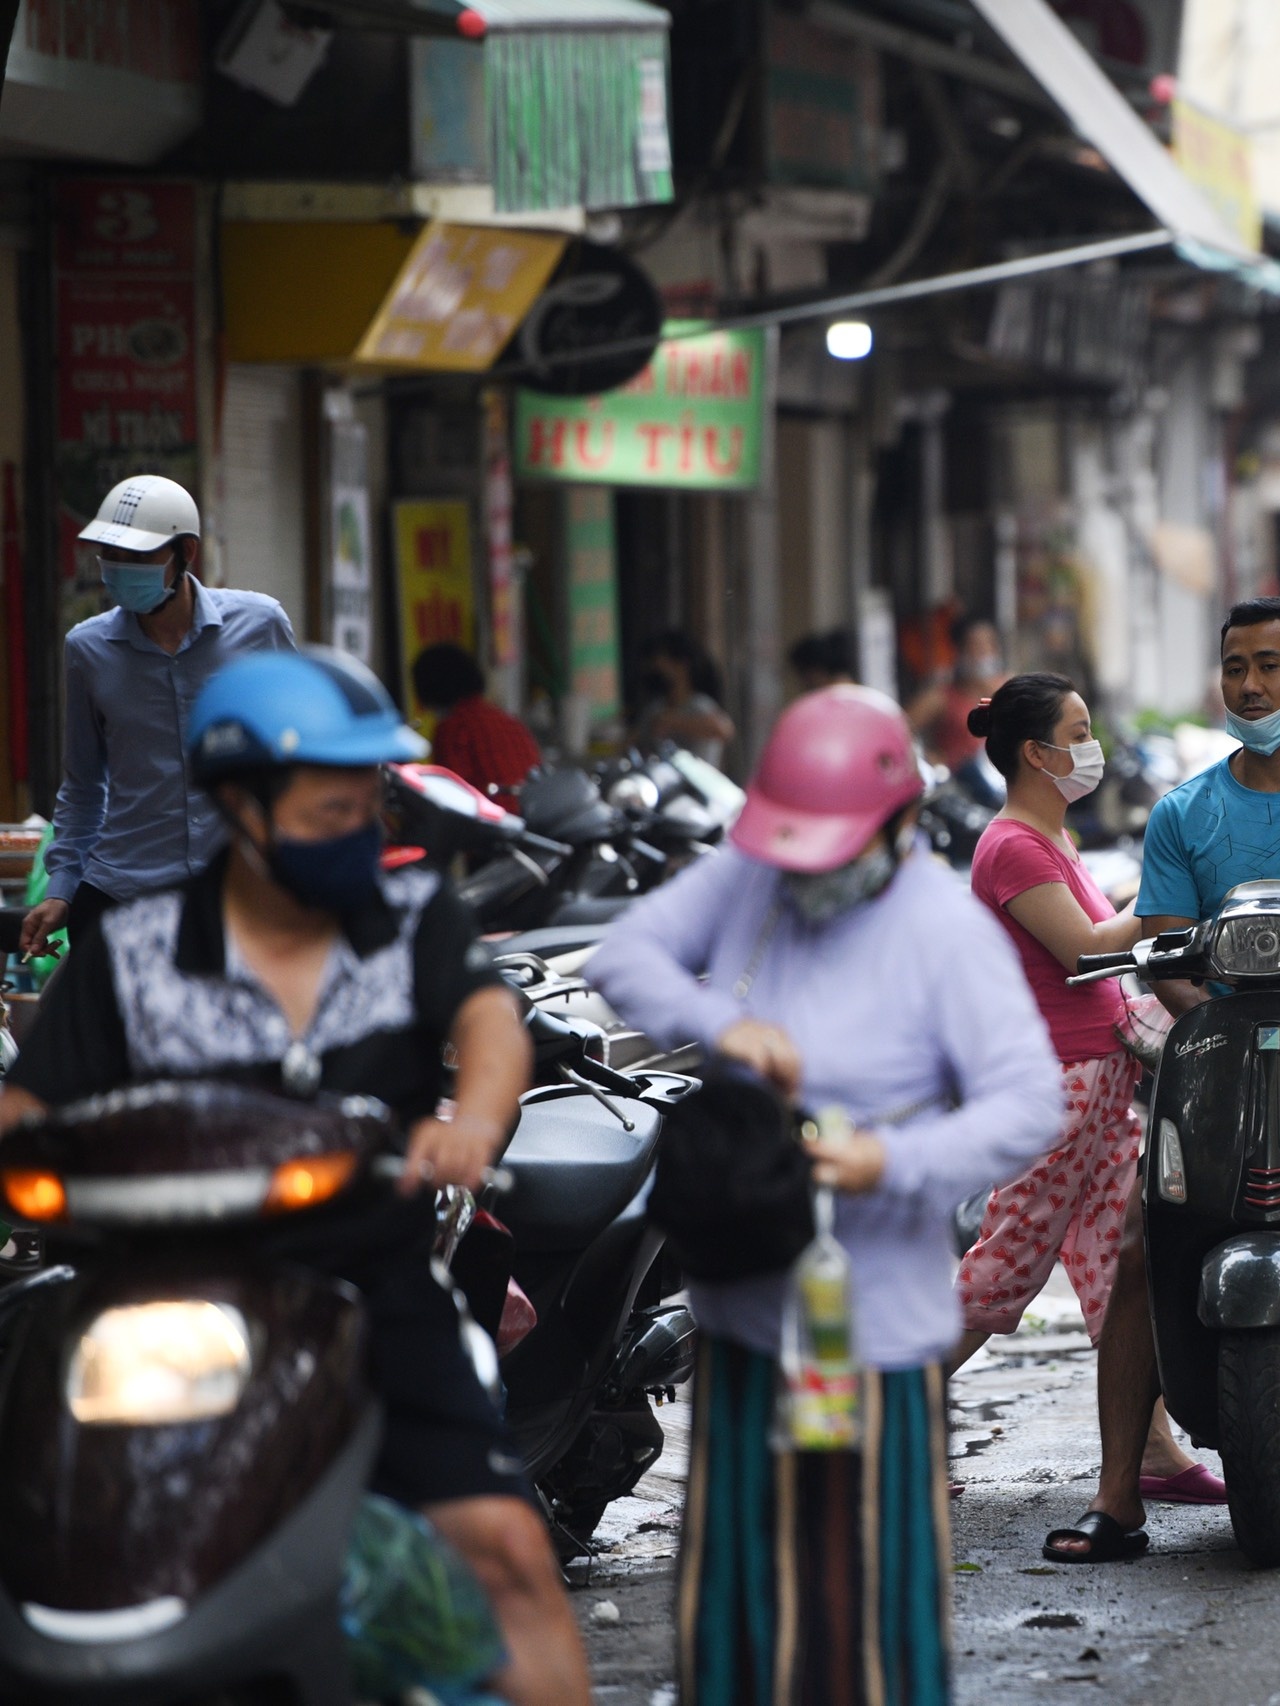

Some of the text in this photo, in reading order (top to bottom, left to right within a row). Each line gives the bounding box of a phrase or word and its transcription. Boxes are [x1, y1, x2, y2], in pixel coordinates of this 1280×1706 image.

[94, 190, 159, 242] 3
[528, 396, 744, 475] HỦ TÍU
[1174, 1033, 1228, 1057] Vespa
